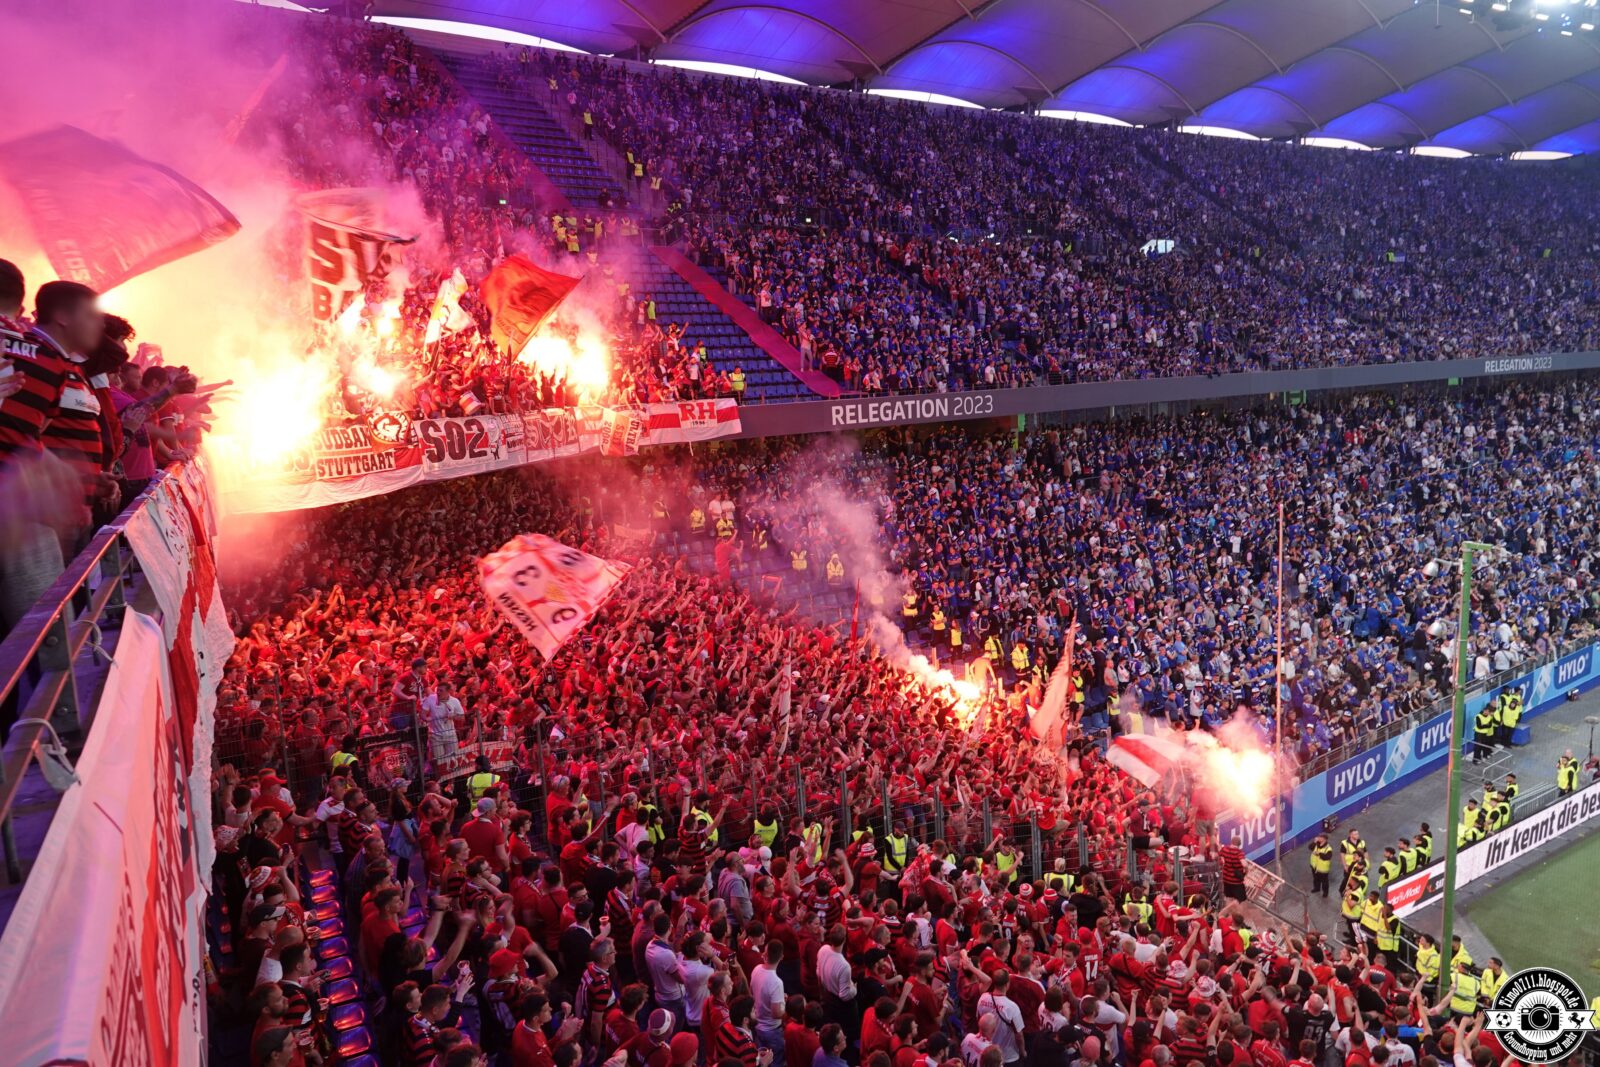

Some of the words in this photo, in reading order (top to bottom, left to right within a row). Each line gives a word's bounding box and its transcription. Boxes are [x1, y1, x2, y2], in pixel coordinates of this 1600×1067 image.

[1485, 358, 1533, 373] RELEGATION
[1534, 356, 1552, 369] 2023
[678, 402, 716, 421] RH
[831, 398, 949, 426] RELEGATION
[953, 394, 993, 416] 2023
[317, 451, 394, 477] STUTTGART
[1558, 656, 1586, 684] HYLO
[1420, 717, 1454, 753] HYLO
[1334, 757, 1376, 798] HYLO
[1485, 838, 1511, 869] Ihr
[1510, 810, 1556, 856] kennt
[1557, 800, 1578, 831] die
